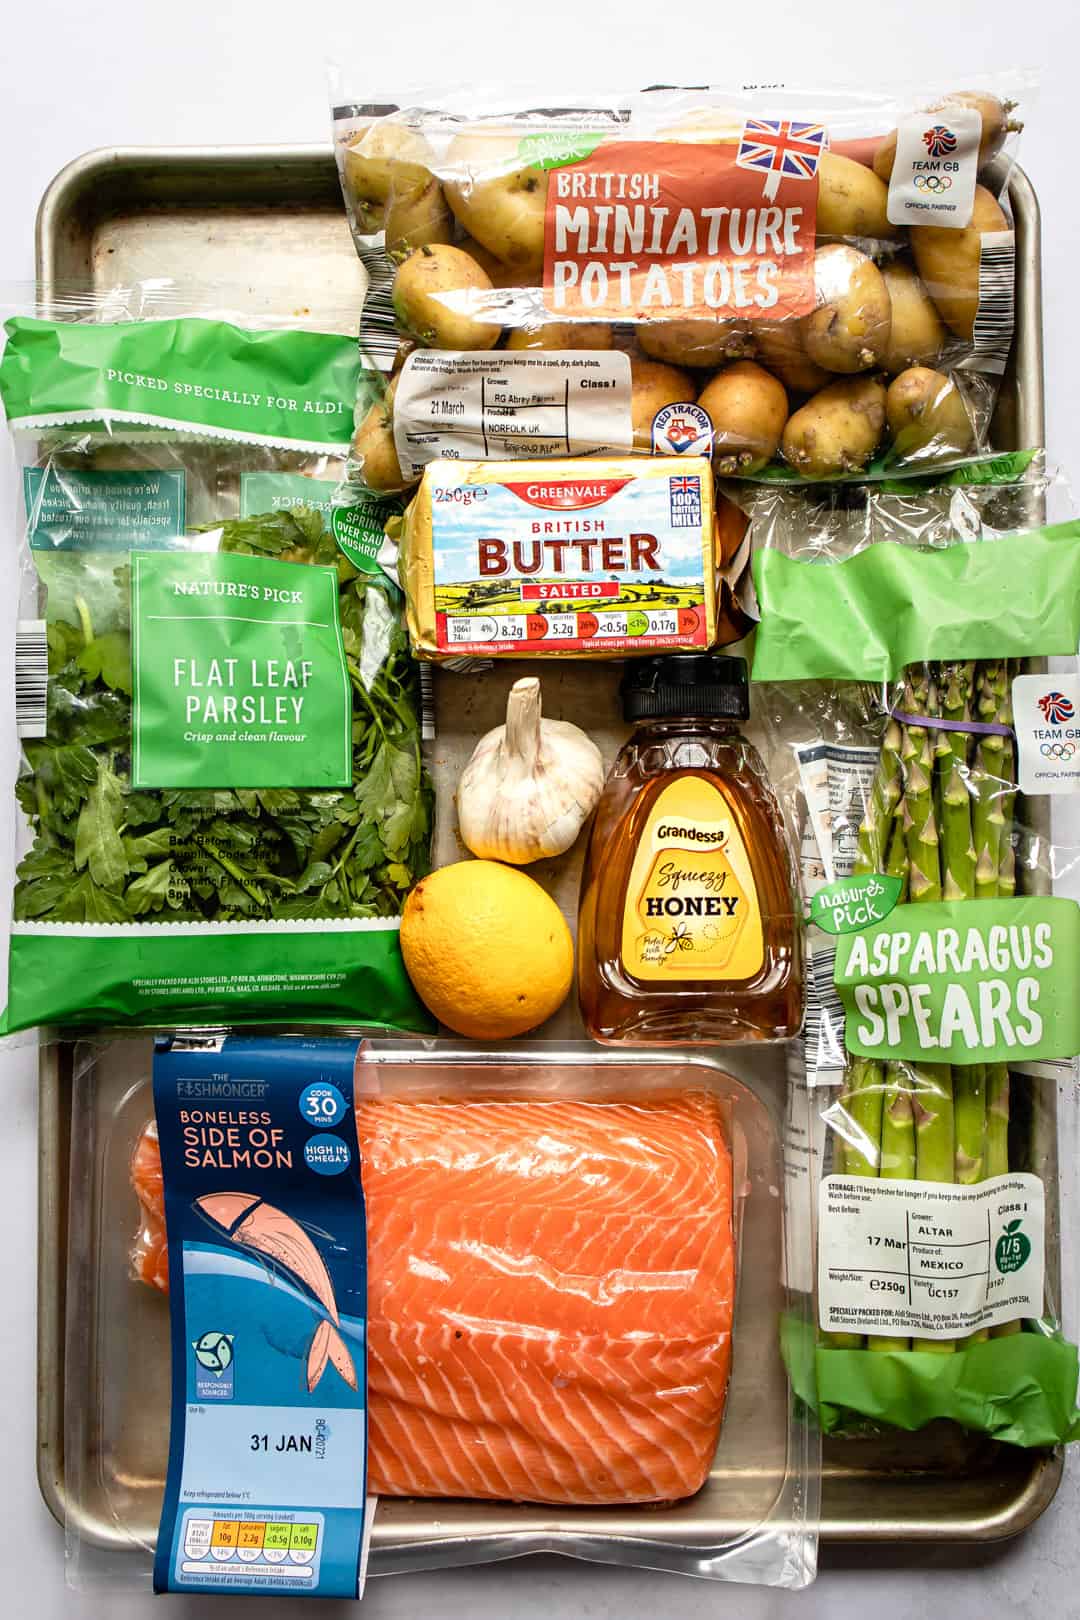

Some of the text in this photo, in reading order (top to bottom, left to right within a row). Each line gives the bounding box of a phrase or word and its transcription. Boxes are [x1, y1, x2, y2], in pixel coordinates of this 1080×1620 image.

[912, 161, 960, 172] TEAM GB
[557, 172, 660, 200] BRITISH
[555, 204, 804, 256] MINIATURE
[553, 261, 779, 309] POTATOES
[580, 379, 609, 388] Class
[107, 368, 344, 415] PICKED SPECIALLY FOR ALDI
[494, 394, 506, 402] RG
[508, 394, 531, 405] Abrey
[431, 400, 465, 414] 21 March
[656, 405, 709, 430] RED TRACTOR
[488, 423, 541, 433] NORFOLK UK
[526, 484, 608, 499] GREENVALE
[671, 493, 700, 505] 100%
[532, 521, 605, 533] BRITISH
[672, 513, 701, 527] MILK
[337, 521, 360, 539] OVER
[340, 533, 377, 559] MUSHRO
[478, 533, 664, 577] BUTTER
[173, 581, 304, 604] NATURE'S PICK
[539, 584, 602, 598] SALTED
[480, 624, 493, 633] 4%
[501, 625, 523, 637] 8.2g
[529, 622, 544, 631] 12%
[552, 623, 574, 636] 5.2g
[600, 622, 628, 634] <0.5g
[651, 620, 676, 632] 0.17g
[173, 658, 313, 689] FLAT LEAF
[185, 696, 306, 725] PARSLEY
[183, 731, 307, 744] Crisp and clean flavour
[1032, 729, 1062, 739] TEAM
[657, 825, 724, 843] Grandessa
[658, 862, 729, 892] Squeezy
[646, 897, 738, 916] HONEY
[845, 923, 1053, 977] ASPARAGUS
[854, 977, 1043, 1049] SPEARS
[213, 1073, 228, 1081] THE
[306, 1097, 337, 1116] 30
[180, 1111, 272, 1125] BONELESS
[183, 1127, 285, 1147] SIDE OF
[306, 1146, 347, 1154] HIGH IN
[185, 1149, 293, 1169] SALMON
[306, 1155, 349, 1163] OMEGA 3
[828, 1183, 856, 1192] STORAGE:
[864, 1185, 876, 1194] keep
[876, 1187, 895, 1196] fresher
[904, 1190, 922, 1199] longer
[922, 1191, 927, 1199] if
[938, 1192, 951, 1202] keep
[828, 1191, 843, 1199] Wash
[844, 1192, 861, 1200] before
[828, 1204, 840, 1213] Best
[998, 1203, 1021, 1215] Class
[918, 1226, 953, 1237] ALTAR
[867, 1235, 906, 1250] 17 Mar
[1002, 1238, 1020, 1255] 1/5
[920, 1260, 964, 1270] MEXICO
[928, 1287, 959, 1298] UC157
[829, 1306, 859, 1316] SPECIALLY
[859, 1308, 880, 1316] PACKED
[881, 1309, 894, 1317] FOR:
[895, 1309, 906, 1317] Aldi
[906, 1310, 921, 1318] Stores
[933, 1313, 941, 1321] PO
[829, 1315, 841, 1323] Aldi
[841, 1316, 857, 1325] Stores
[250, 1434, 312, 1452] 31 JAN
[218, 1532, 232, 1543] 10g
[243, 1534, 258, 1545] 2.2g
[266, 1535, 288, 1546] <0.5g
[293, 1535, 312, 1546] 0.10g
